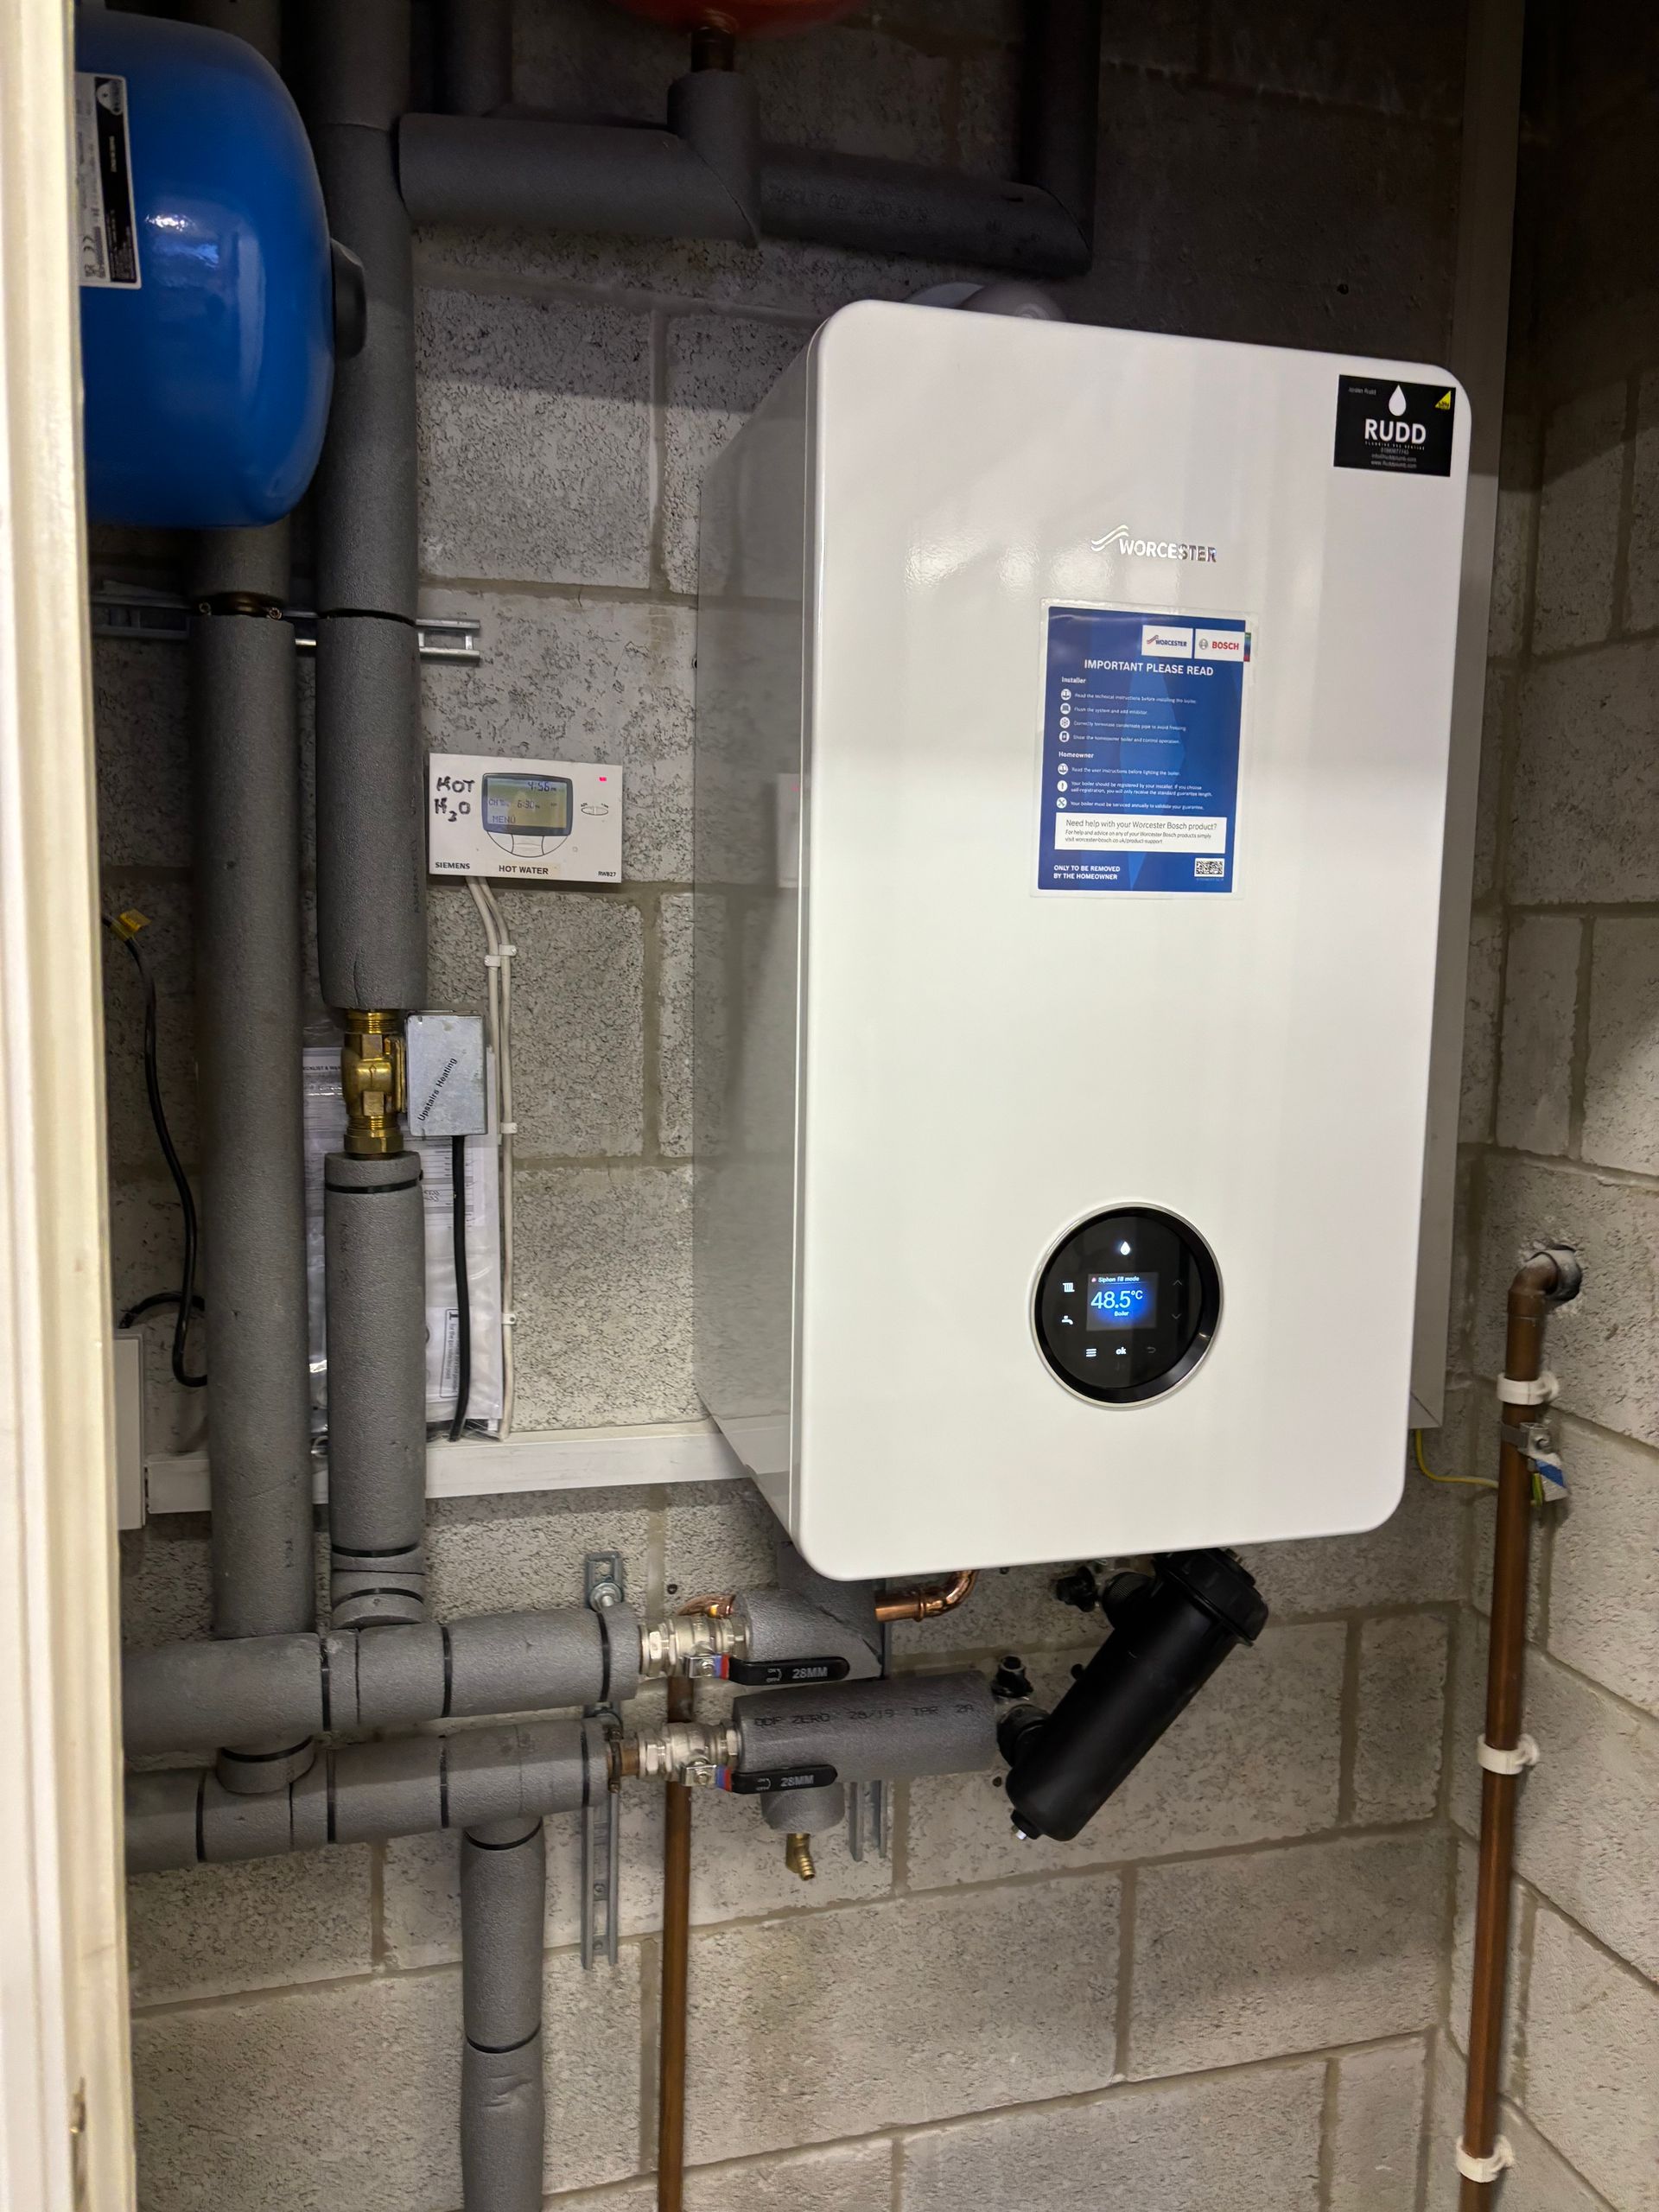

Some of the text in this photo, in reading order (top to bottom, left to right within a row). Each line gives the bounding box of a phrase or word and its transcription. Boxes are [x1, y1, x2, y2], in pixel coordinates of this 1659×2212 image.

[1365, 418, 1426, 444] RUDD
[1119, 538, 1217, 563] WORCESTER
[1155, 639, 1239, 650] WORCESTER BOSCH
[1084, 659, 1214, 676] IMPORTANT PLEASE READ
[436, 776, 475, 793] HOT
[492, 815, 516, 823] MENU
[519, 866, 549, 875] WATER
[435, 1058, 458, 1087] Heating
[1091, 1290, 1143, 1309] 48.5°C
[792, 1667, 828, 1679] 28MM
[791, 1713, 830, 1724] ZERO
[781, 1775, 814, 1787] 28MM
